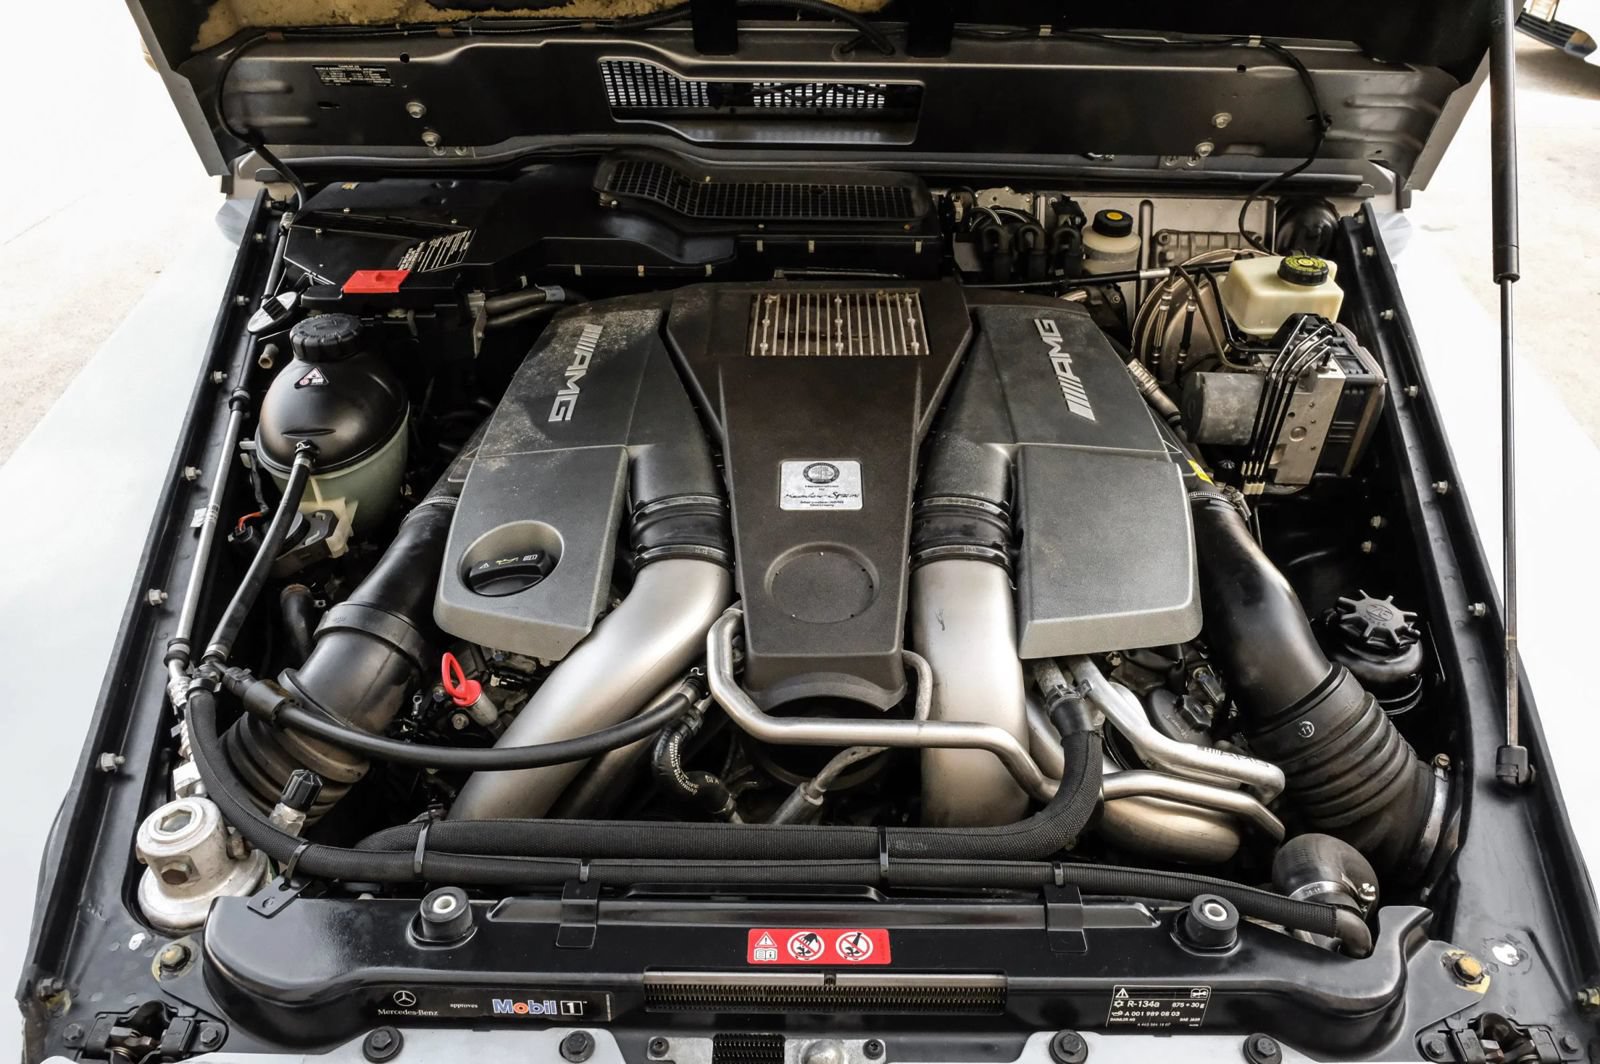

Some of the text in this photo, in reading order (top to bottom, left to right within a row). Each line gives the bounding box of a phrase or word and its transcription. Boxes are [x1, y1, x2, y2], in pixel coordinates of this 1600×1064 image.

[1034, 319, 1083, 388] AMG
[547, 346, 595, 422] AMG
[377, 1008, 439, 1016] Mercedes-Benz
[492, 999, 558, 1015] Mobil
[1127, 1000, 1160, 1008] R-134a
